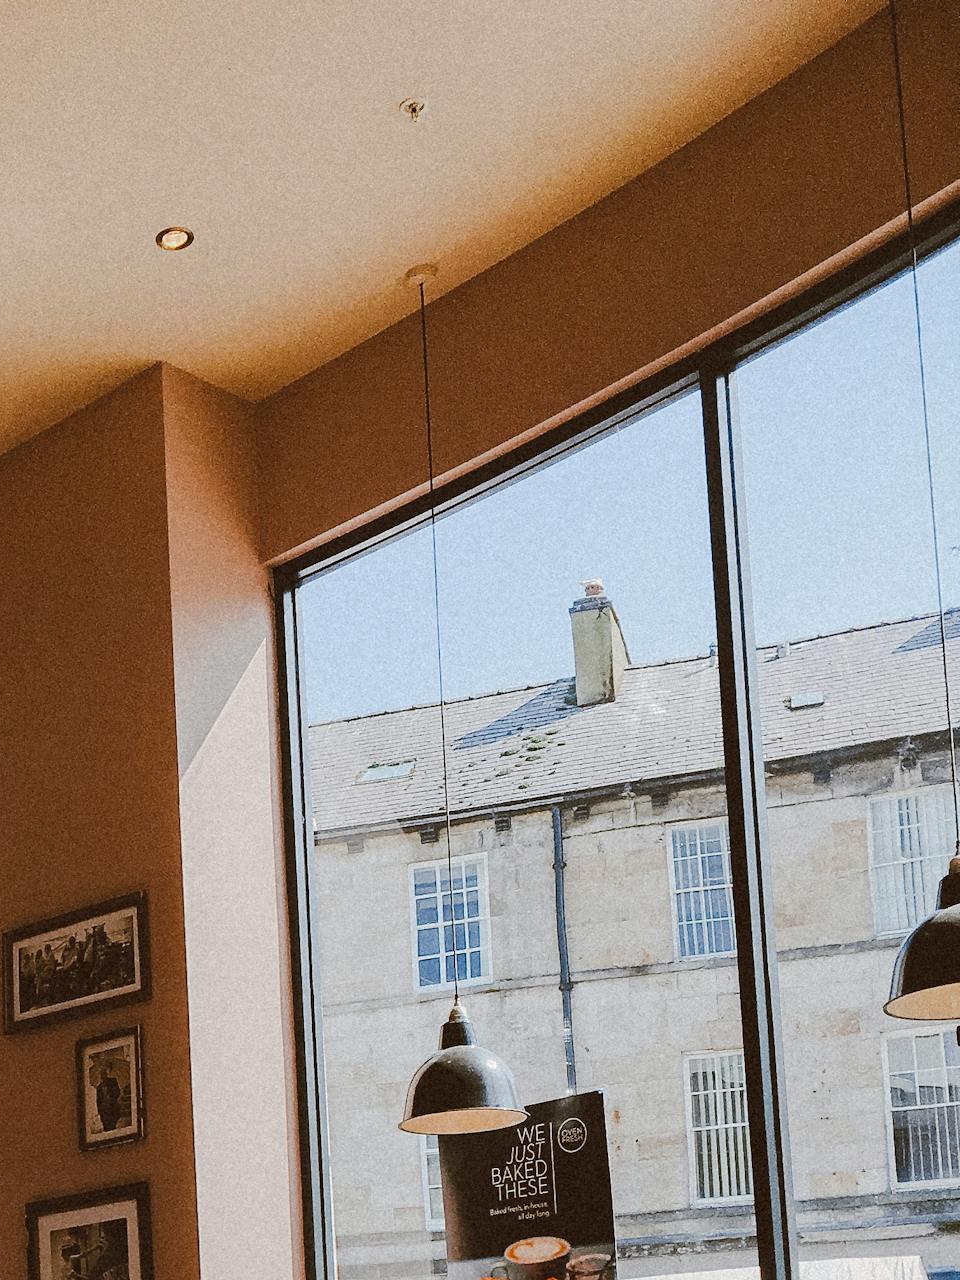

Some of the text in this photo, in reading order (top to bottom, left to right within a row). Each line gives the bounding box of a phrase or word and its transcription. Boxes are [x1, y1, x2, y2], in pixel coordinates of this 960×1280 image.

[516, 1123, 546, 1144] WE
[561, 1127, 583, 1137] OVEN
[561, 1134, 584, 1144] FRESH
[506, 1141, 546, 1164] JUST
[491, 1160, 548, 1185] BAKED
[495, 1177, 549, 1201] THESE
